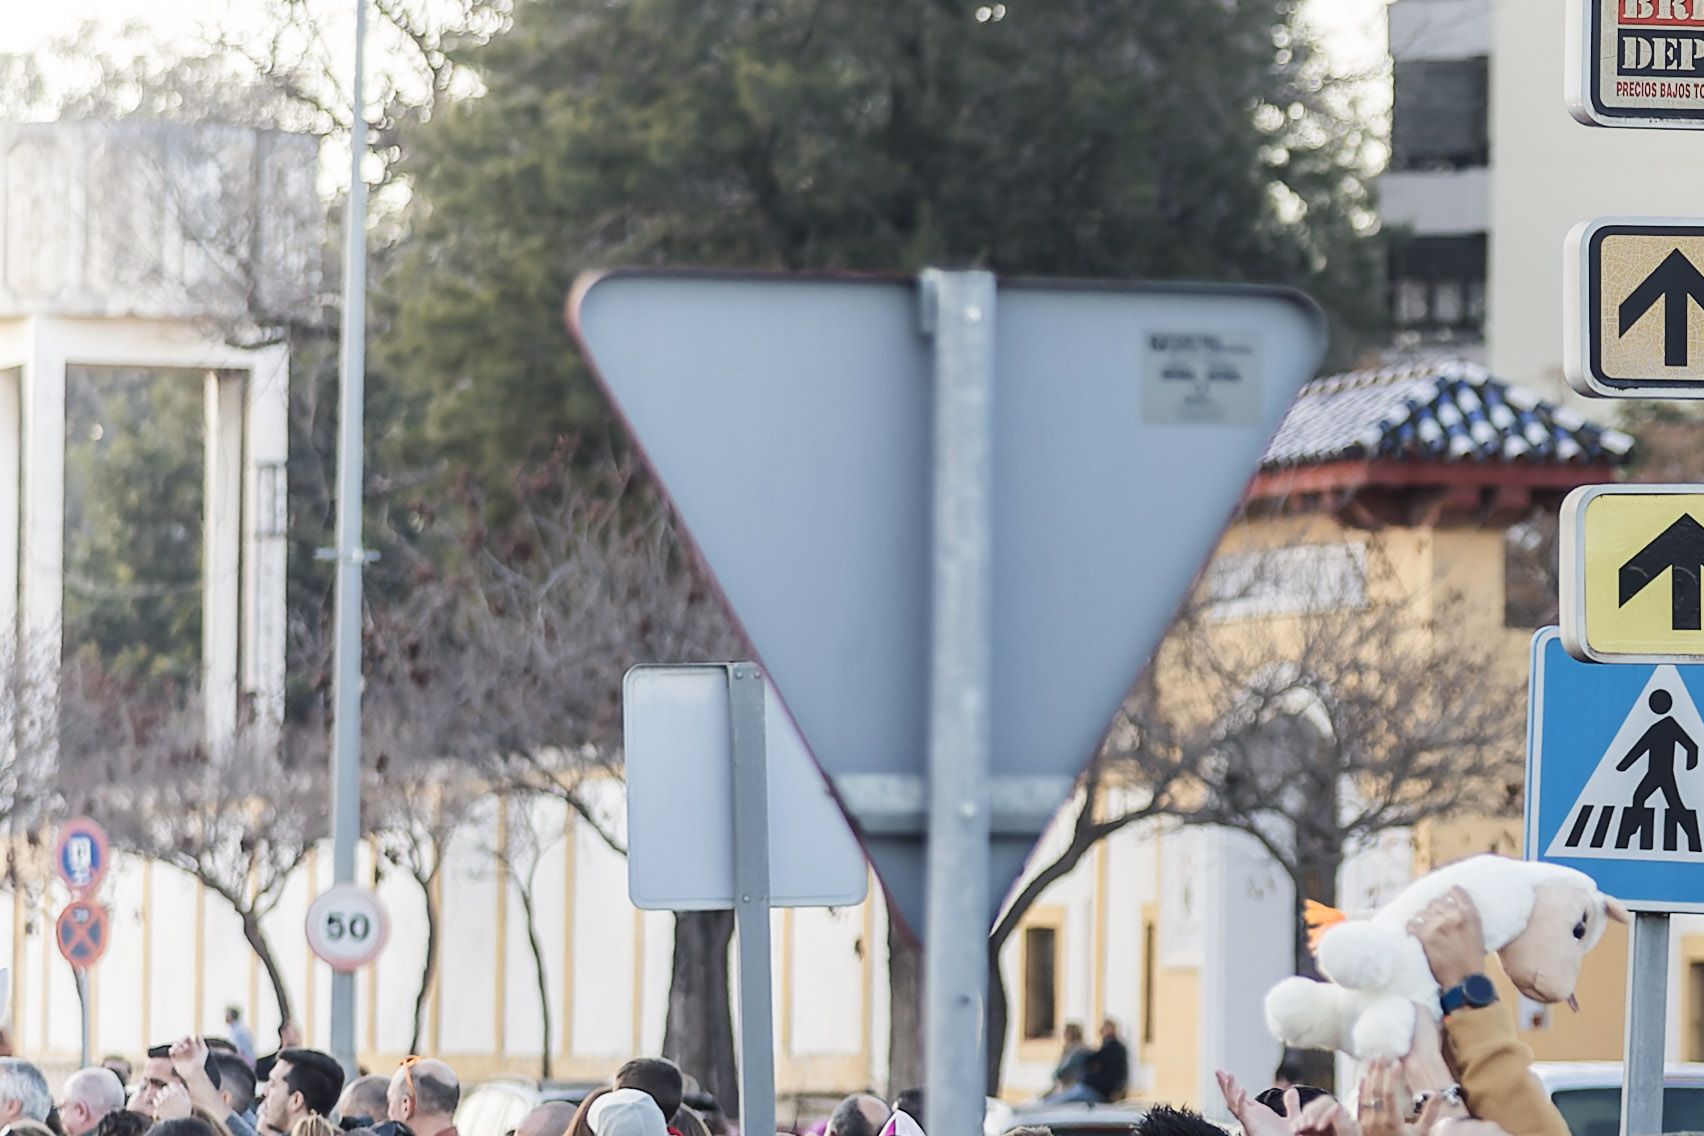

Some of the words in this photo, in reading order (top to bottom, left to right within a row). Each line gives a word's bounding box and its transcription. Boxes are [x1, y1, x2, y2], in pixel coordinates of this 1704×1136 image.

[1616, 81, 1657, 97] PRECIOS
[1660, 82, 1691, 99] BAJOS
[327, 911, 370, 941] 50
